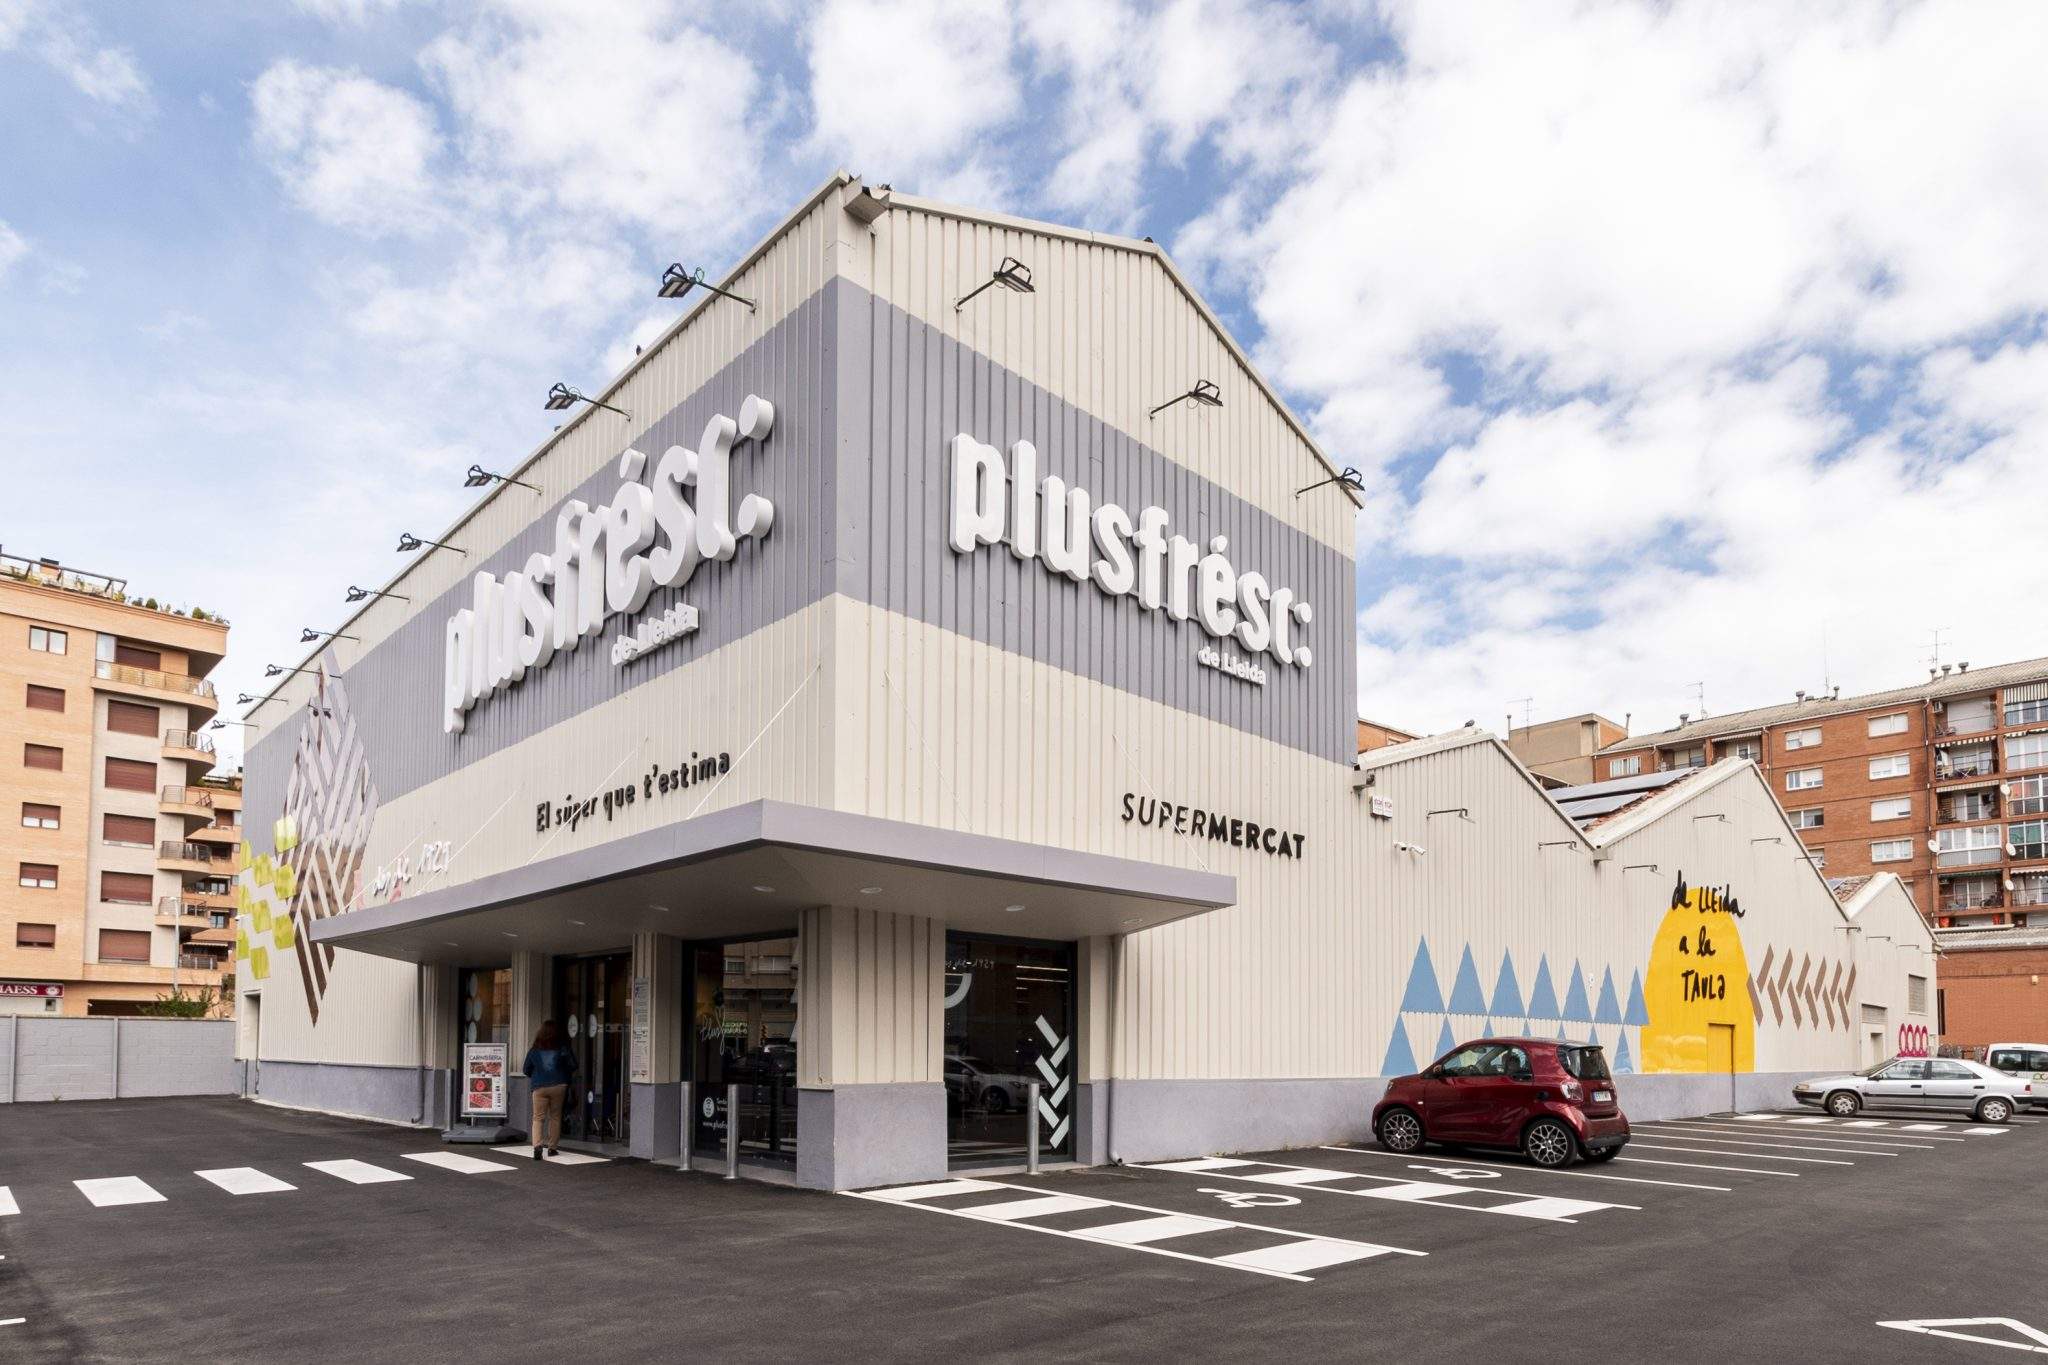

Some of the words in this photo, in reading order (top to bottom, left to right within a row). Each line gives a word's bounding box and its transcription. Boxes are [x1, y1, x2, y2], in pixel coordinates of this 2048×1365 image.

[611, 635, 638, 666] de
[637, 602, 698, 656] Lleida
[1198, 646, 1220, 667] de
[1221, 652, 1266, 685] Lleida
[536, 801, 550, 832] El
[556, 794, 598, 832] súper
[603, 784, 635, 821] que
[644, 751, 730, 799] t'estima
[1121, 793, 1305, 859] SUPERMERCAT
[1671, 870, 1692, 911] de
[1678, 936, 1690, 955] a
[1696, 925, 1716, 957] la
